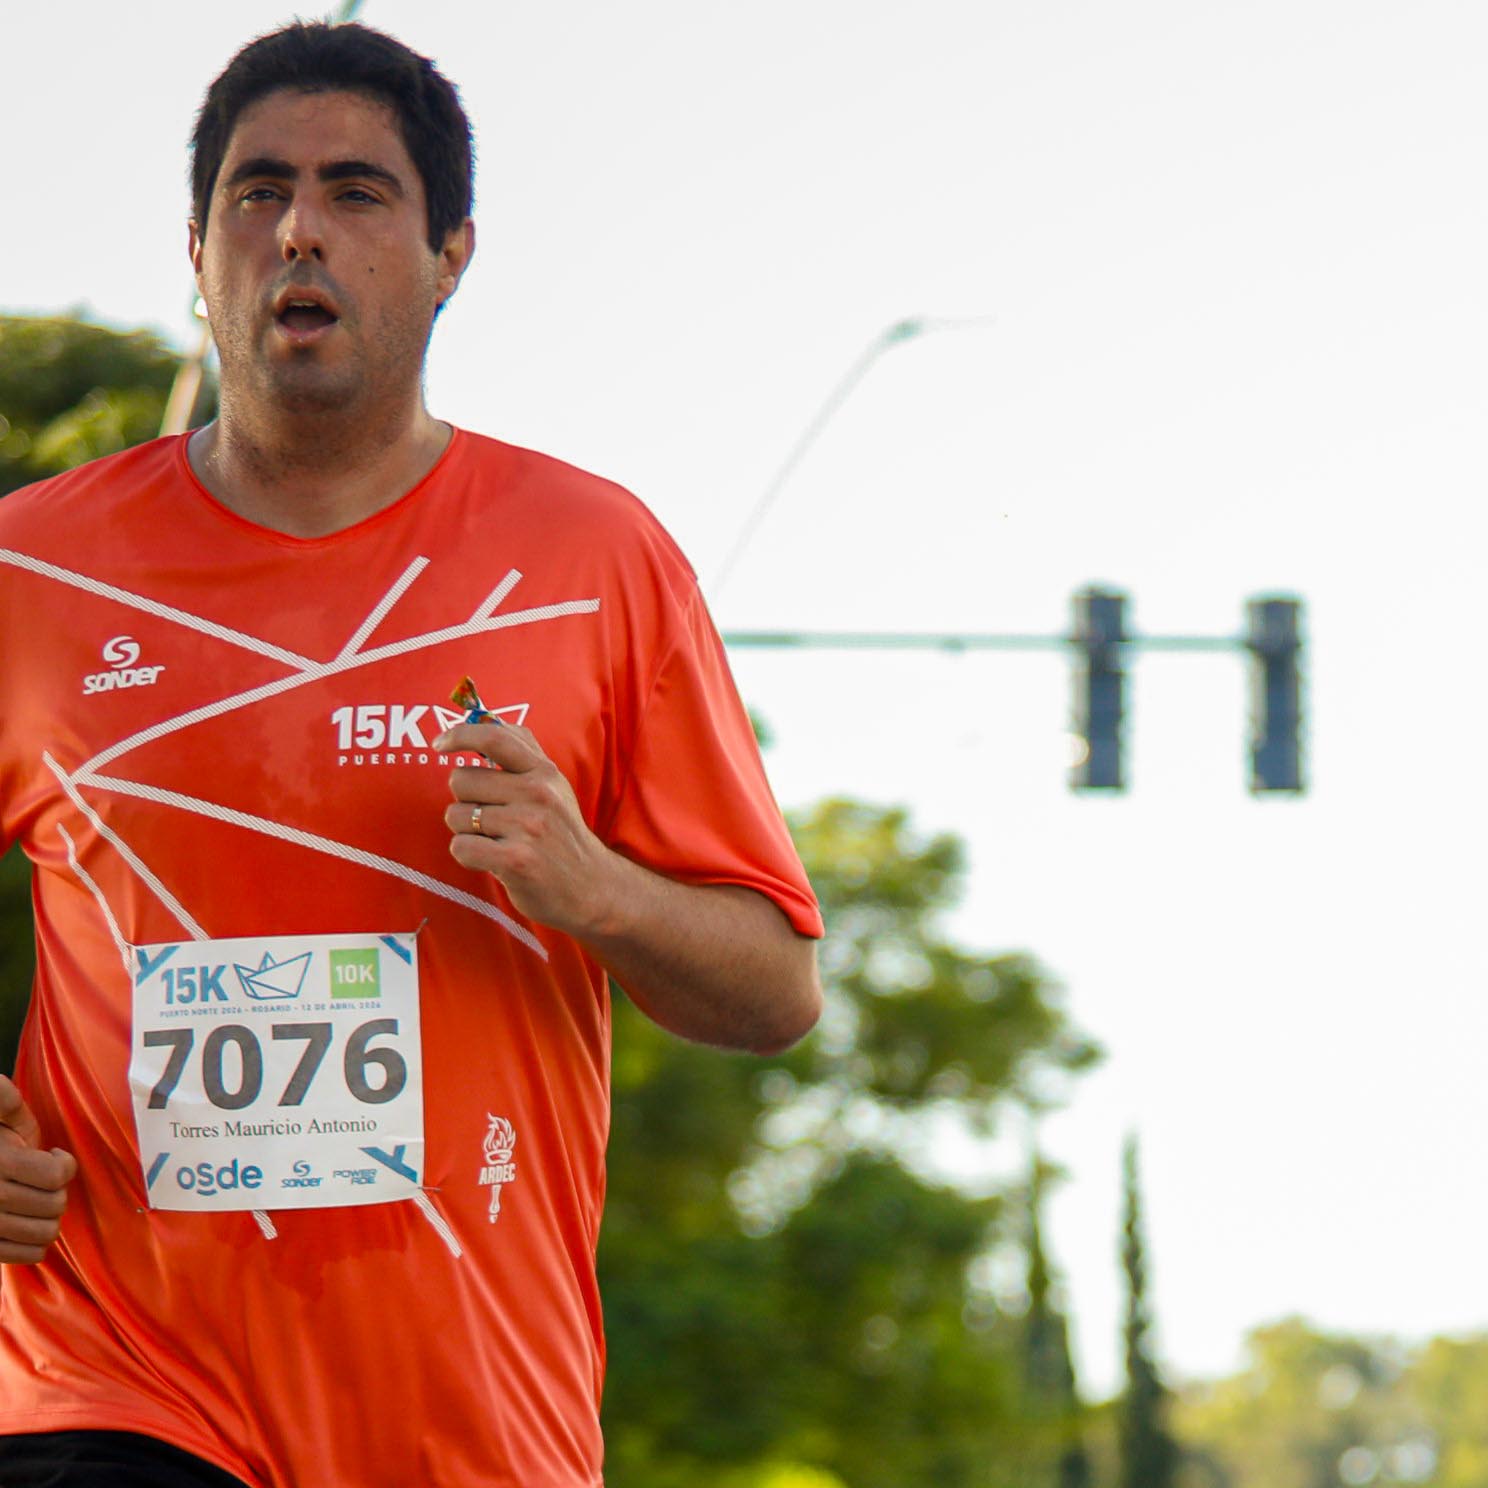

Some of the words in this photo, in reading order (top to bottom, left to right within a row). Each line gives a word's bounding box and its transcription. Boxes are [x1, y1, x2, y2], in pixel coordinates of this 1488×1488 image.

[331, 704, 430, 750] 15K
[338, 753, 429, 767] PUERTO
[439, 754, 481, 767] NOR
[161, 964, 229, 1004] 15K
[335, 964, 375, 984] 10K
[143, 1018, 408, 1110] 7076
[169, 1121, 219, 1138] Torres
[224, 1119, 302, 1137] Mauricio
[307, 1116, 377, 1134] Antonio
[177, 1158, 263, 1193] osde
[333, 1168, 377, 1179] POWER
[478, 1162, 517, 1185] ARDEC
